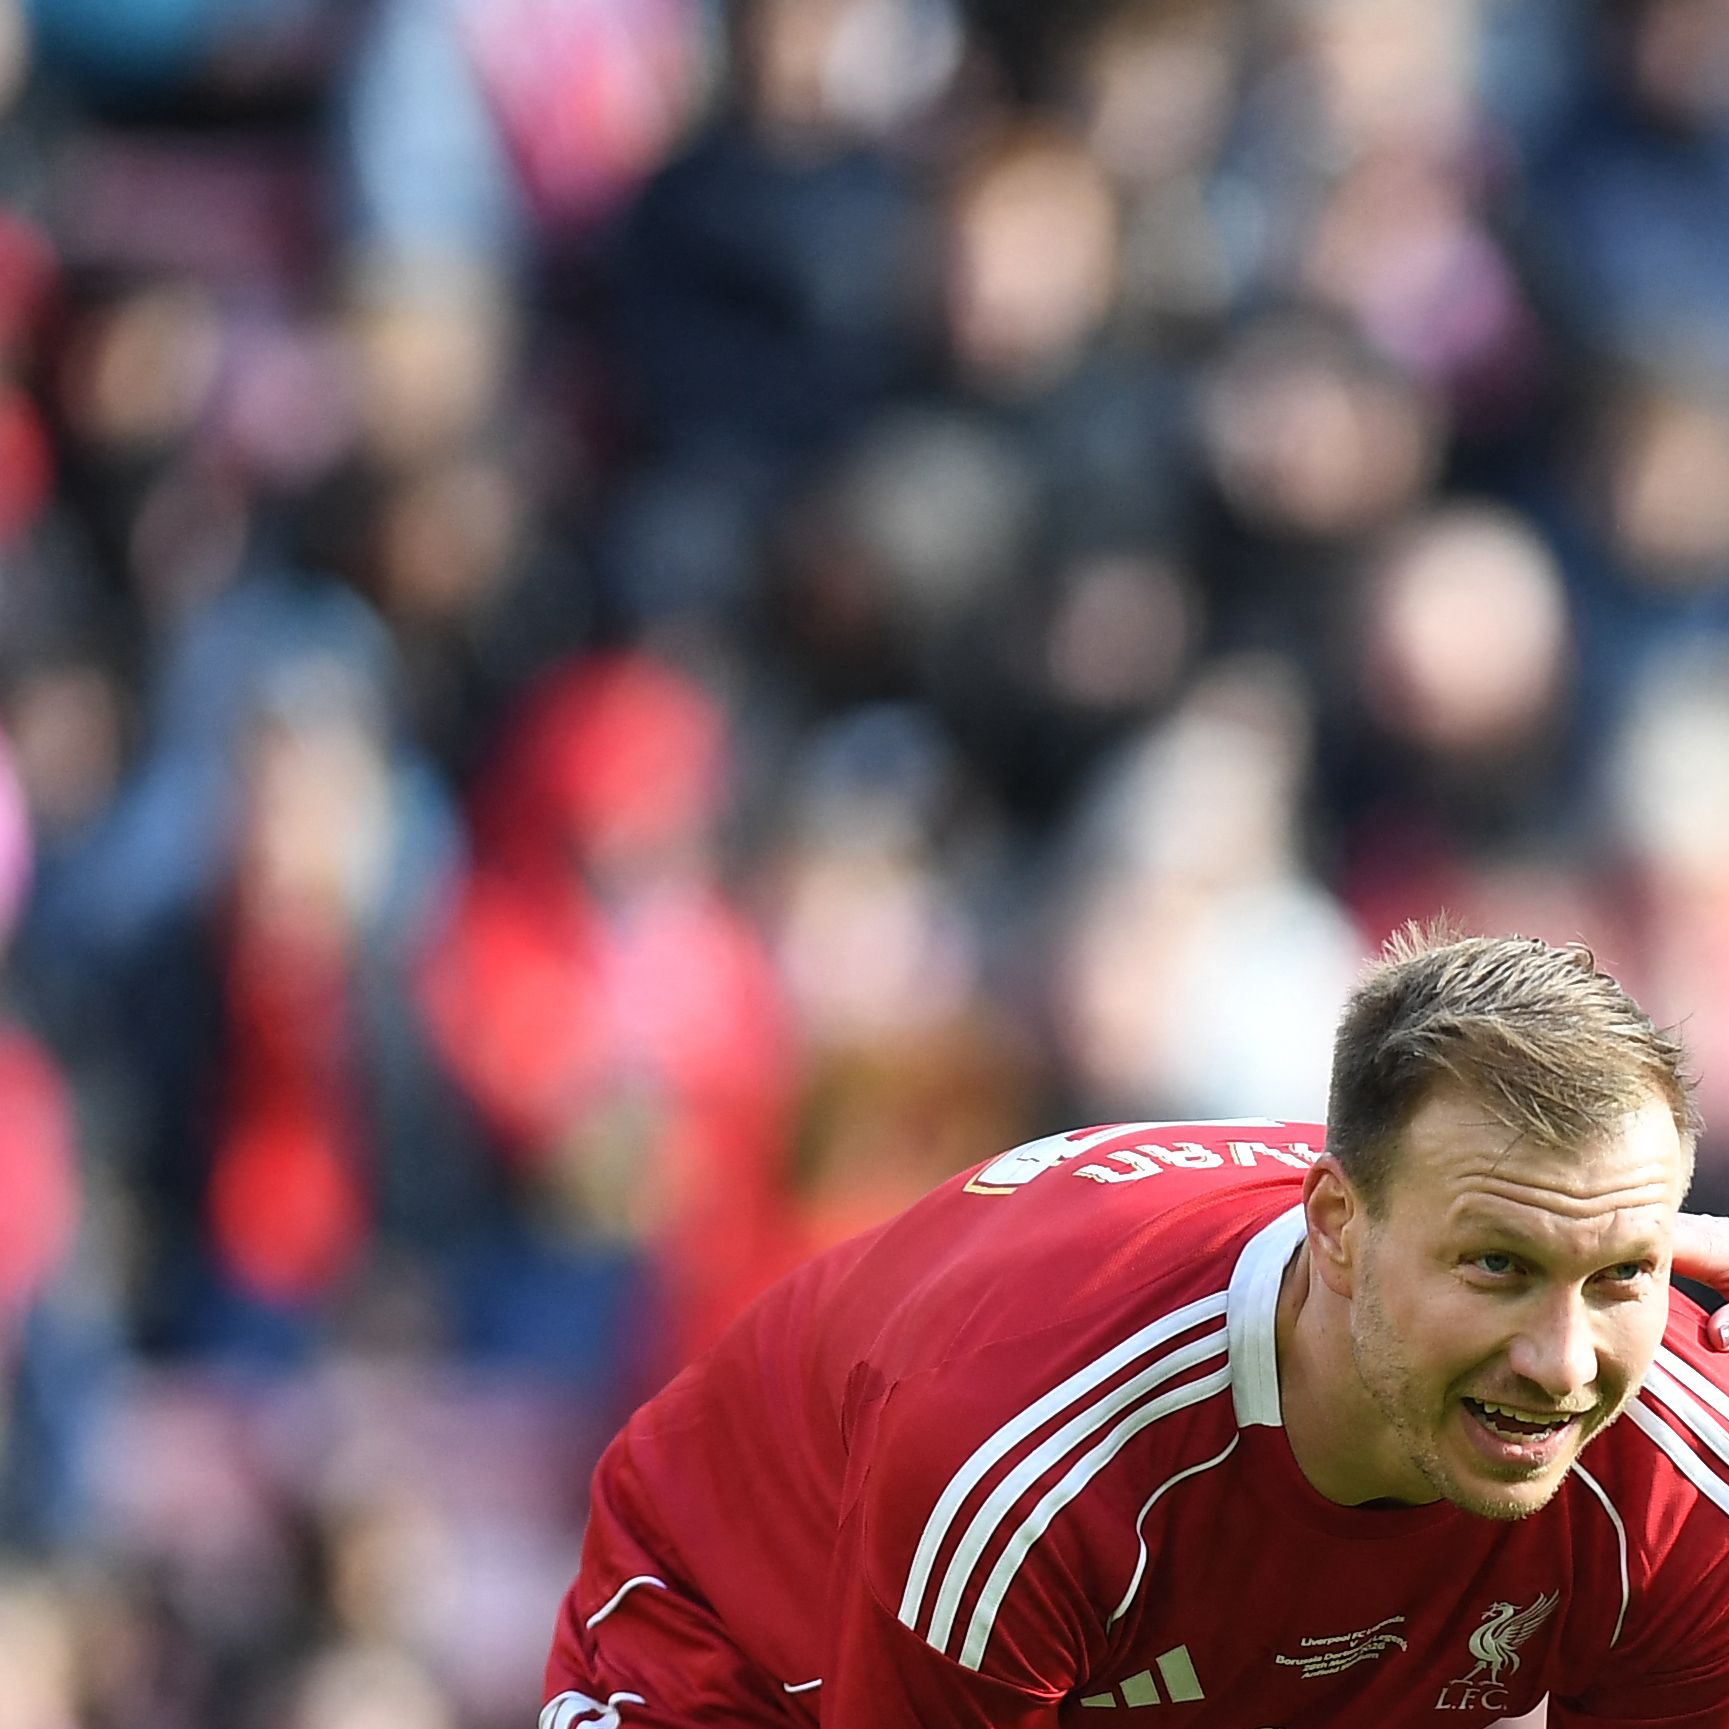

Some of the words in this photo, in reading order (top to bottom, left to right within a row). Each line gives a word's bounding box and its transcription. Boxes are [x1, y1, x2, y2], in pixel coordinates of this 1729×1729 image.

[1300, 1633, 1352, 1648] Liverpool
[1275, 1654, 1323, 1666] Borussia
[1434, 1687, 1509, 1710] L.F.C.
